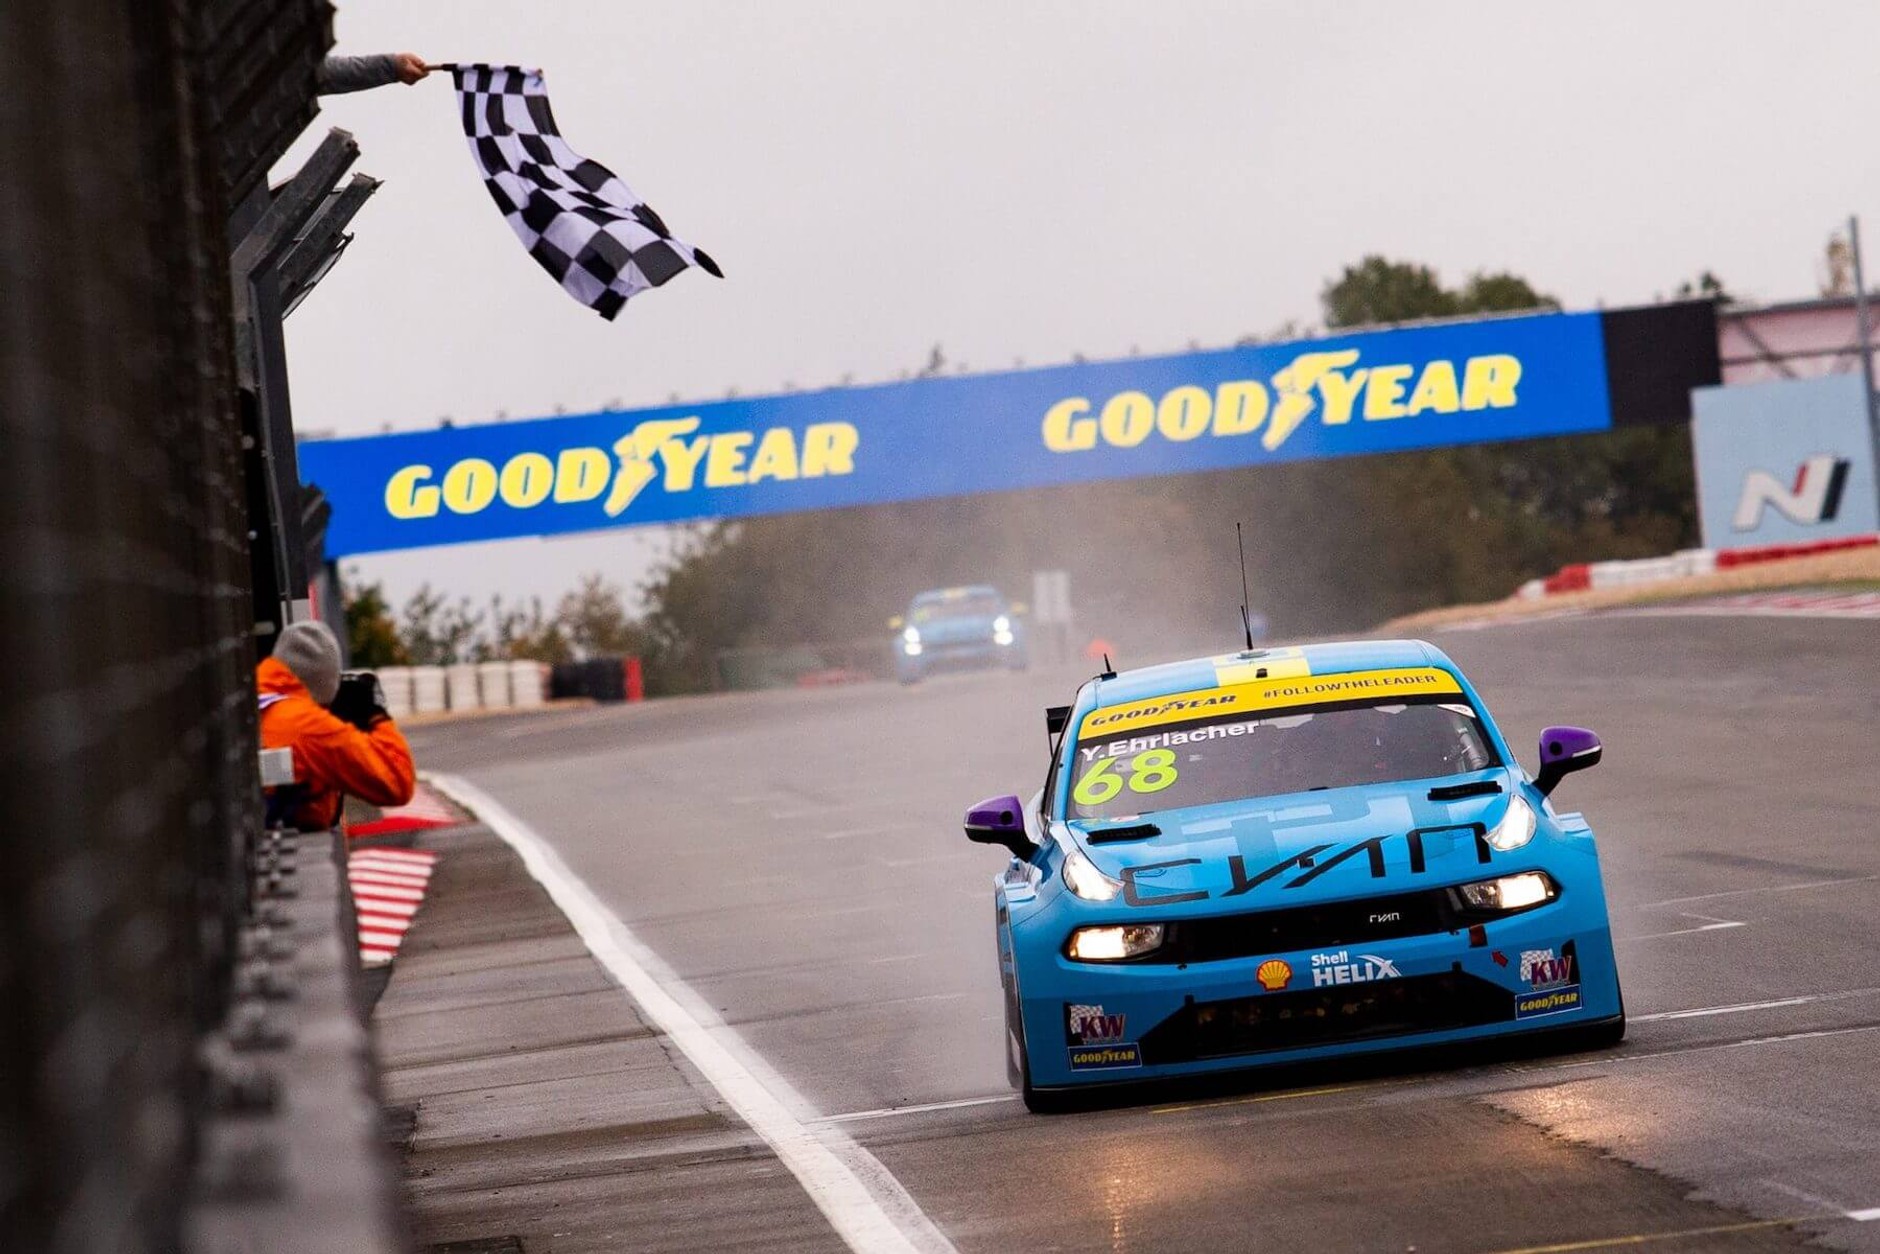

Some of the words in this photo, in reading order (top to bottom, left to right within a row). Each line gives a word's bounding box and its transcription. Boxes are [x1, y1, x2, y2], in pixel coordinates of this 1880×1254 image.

[1042, 349, 1522, 452] GOODYEAR
[385, 416, 859, 519] GOODYEAR
[1264, 675, 1437, 698] #FOLLOWTHELEADER
[1091, 695, 1236, 726] GOODYEAR
[1073, 748, 1178, 805] 68
[1311, 950, 1348, 967] Shell
[1312, 954, 1402, 987] HELIX
[1530, 955, 1572, 985] KW
[1520, 992, 1578, 1011] GOODYEAR
[1080, 1013, 1125, 1039] KW
[1073, 1050, 1135, 1064] GOODYEAR
